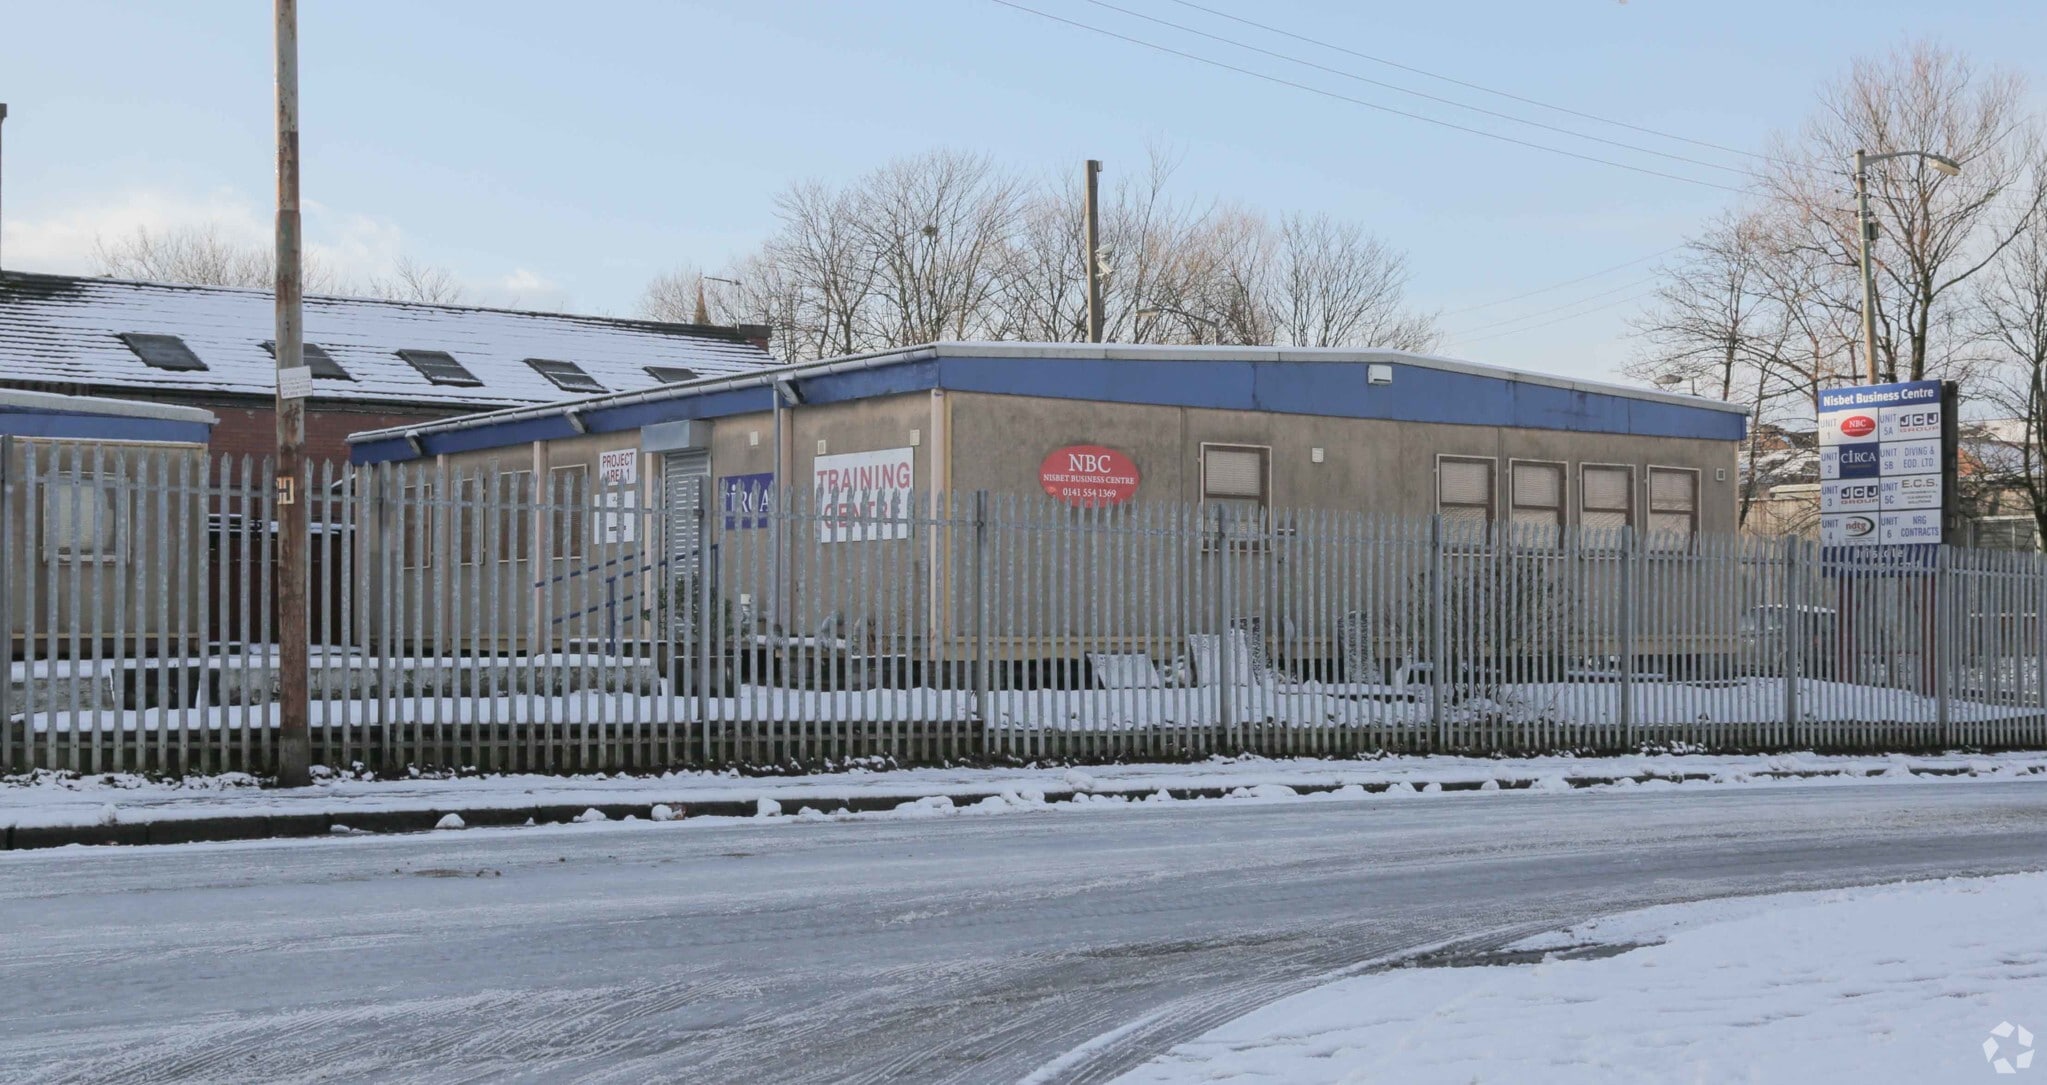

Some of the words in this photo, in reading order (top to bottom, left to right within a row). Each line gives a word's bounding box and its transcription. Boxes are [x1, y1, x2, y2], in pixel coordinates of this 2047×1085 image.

[1823, 394, 1854, 407] Nisbet
[1856, 389, 1899, 404] Business
[1901, 387, 1934, 400] Centre
[1820, 418, 1837, 429] UNIT
[1848, 418, 1866, 428] NBC
[1880, 413, 1897, 424] UNIT
[1899, 412, 1939, 427] JCJ
[1883, 426, 1894, 436] 5A
[1880, 447, 1897, 458] UNIT
[1904, 446, 1928, 457] DIVING
[1929, 445, 1935, 455] &
[602, 452, 634, 469] PROJECT
[1821, 452, 1838, 462] UNIT
[1068, 453, 1111, 474] NBC
[1827, 465, 1832, 474] 2
[605, 468, 627, 483] AREA
[816, 462, 910, 494] TRAINING
[1043, 473, 1070, 482] NISBET
[1071, 474, 1105, 483] BUSINESS
[1105, 476, 1135, 485] CENTRE
[1881, 482, 1898, 492] UNIT
[1901, 478, 1939, 489] E.C.S.
[1062, 487, 1081, 496] 0141
[1083, 488, 1097, 497] 554
[1099, 488, 1117, 498] 1369
[1822, 485, 1839, 495] UNIT
[1840, 485, 1879, 499] JCJ
[1827, 498, 1832, 507] 3
[1822, 519, 1839, 529] UNIT
[1881, 517, 1898, 527] UNIT
[1912, 515, 1927, 525] NRG
[1828, 531, 1833, 540] 4
[1887, 529, 1892, 539] 6
[1900, 526, 1939, 537] CONTRACTS
